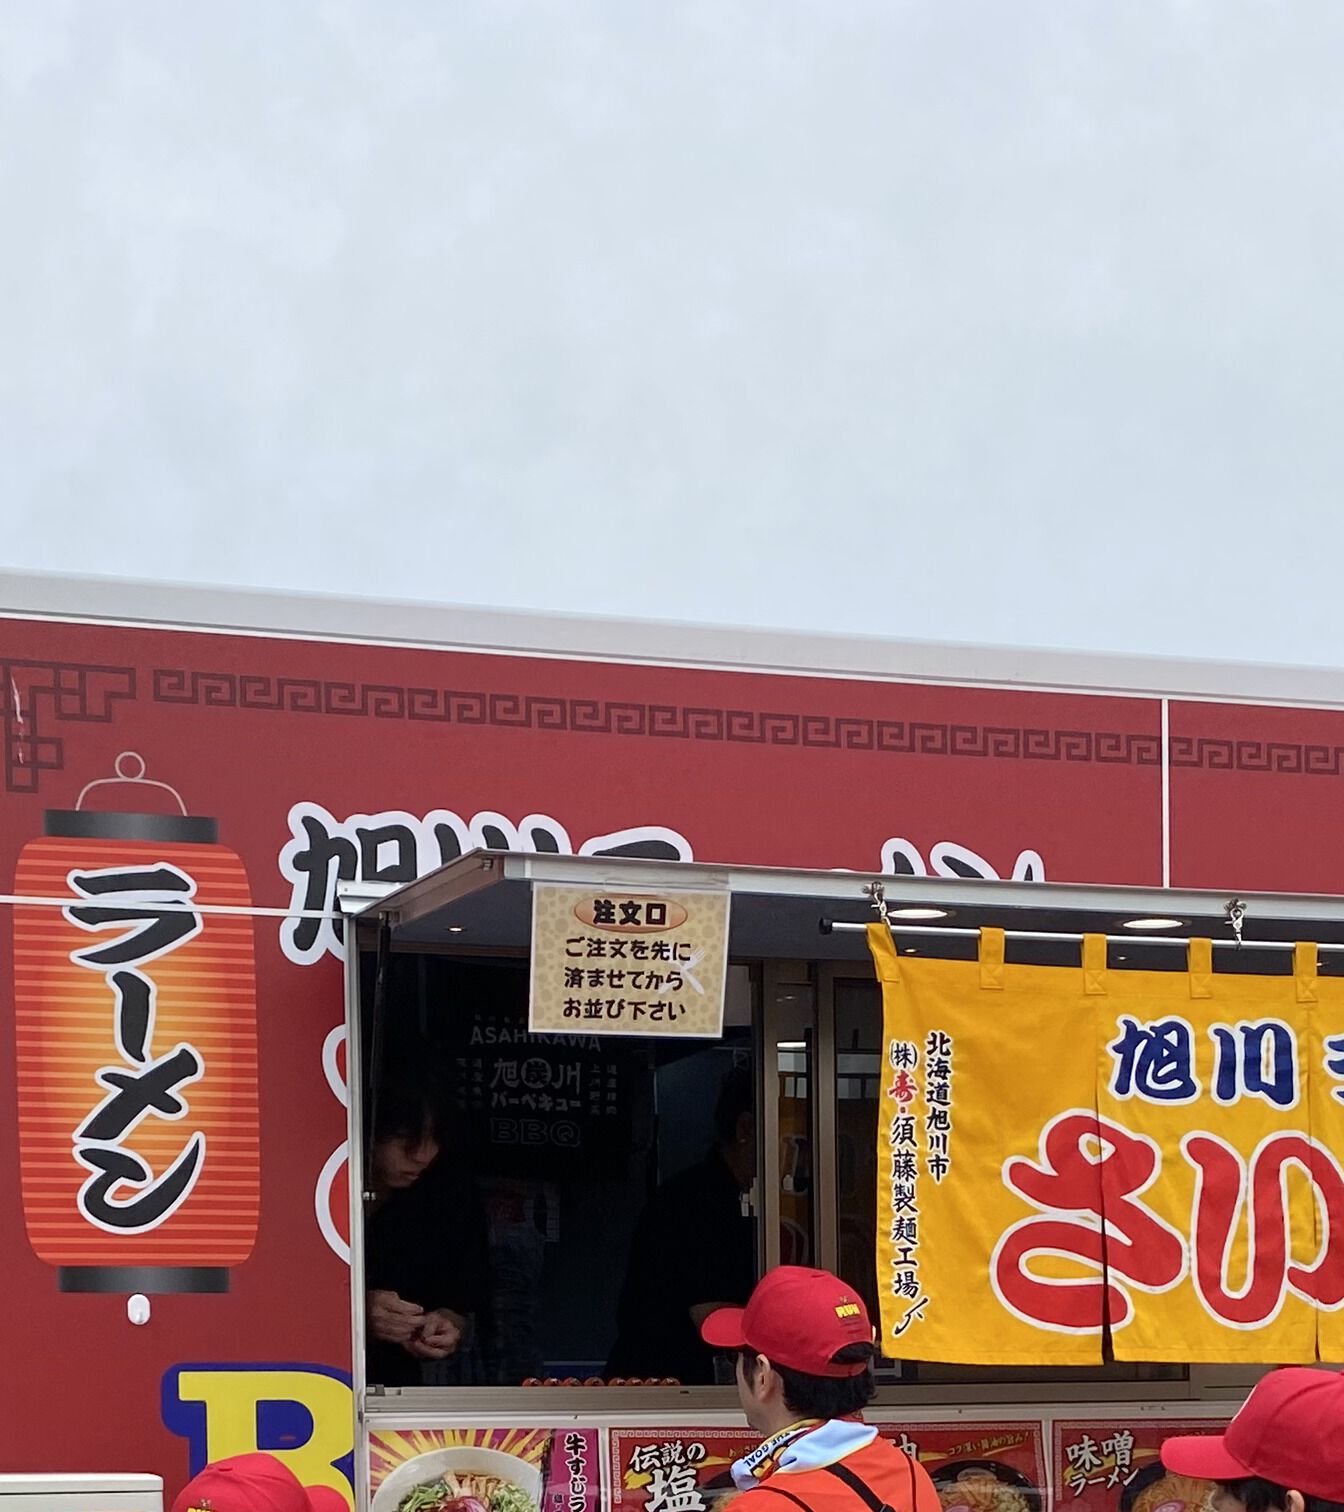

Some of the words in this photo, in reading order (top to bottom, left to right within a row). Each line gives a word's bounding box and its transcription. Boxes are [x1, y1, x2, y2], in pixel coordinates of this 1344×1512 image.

[592, 899, 667, 926] 注文口
[564, 936, 692, 961] ご注文を先に
[563, 966, 684, 991] 済ませてから
[562, 997, 686, 1021] お並び下さい
[62, 861, 205, 1236] ラーメン
[925, 1030, 952, 1183] 北海道旭川市
[630, 1439, 707, 1472] 伝説の
[1065, 1429, 1136, 1473] 味噌
[1067, 1465, 1140, 1497] ラーメン
